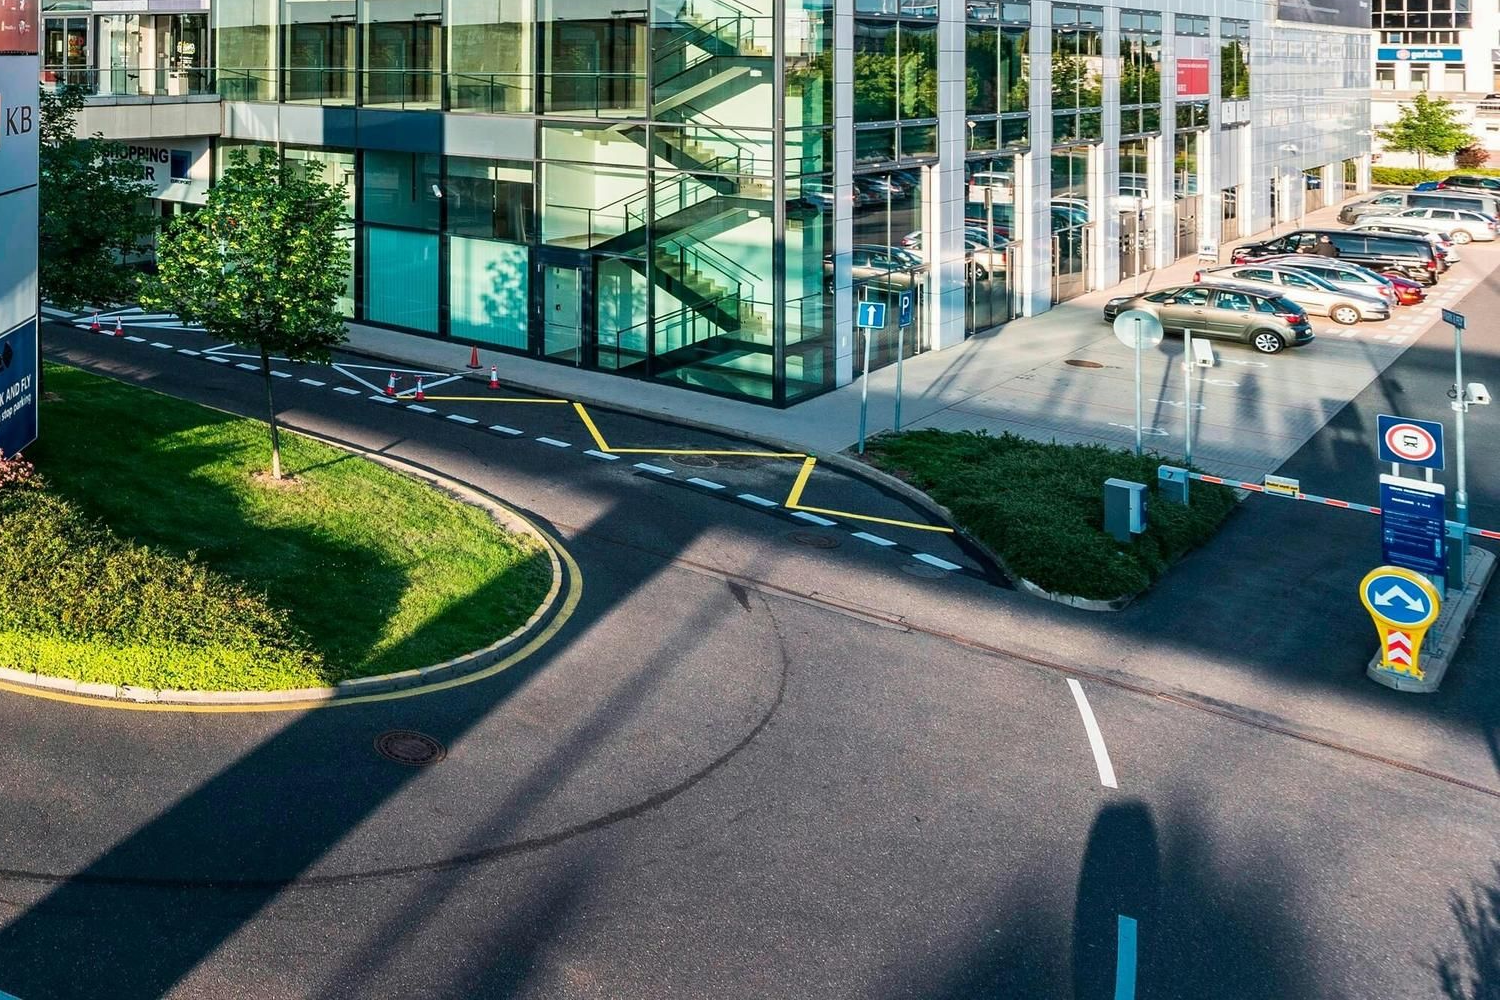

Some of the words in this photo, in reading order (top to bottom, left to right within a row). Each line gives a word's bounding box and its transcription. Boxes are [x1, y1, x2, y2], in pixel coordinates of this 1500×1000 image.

[1411, 49, 1444, 60] gerlach
[5, 105, 32, 137] KB
[902, 296, 910, 316] P
[5, 382, 20, 402] AND
[21, 373, 32, 393] FLY
[1, 407, 13, 422] stop
[13, 393, 32, 415] parking
[1166, 470, 1174, 479] 7
